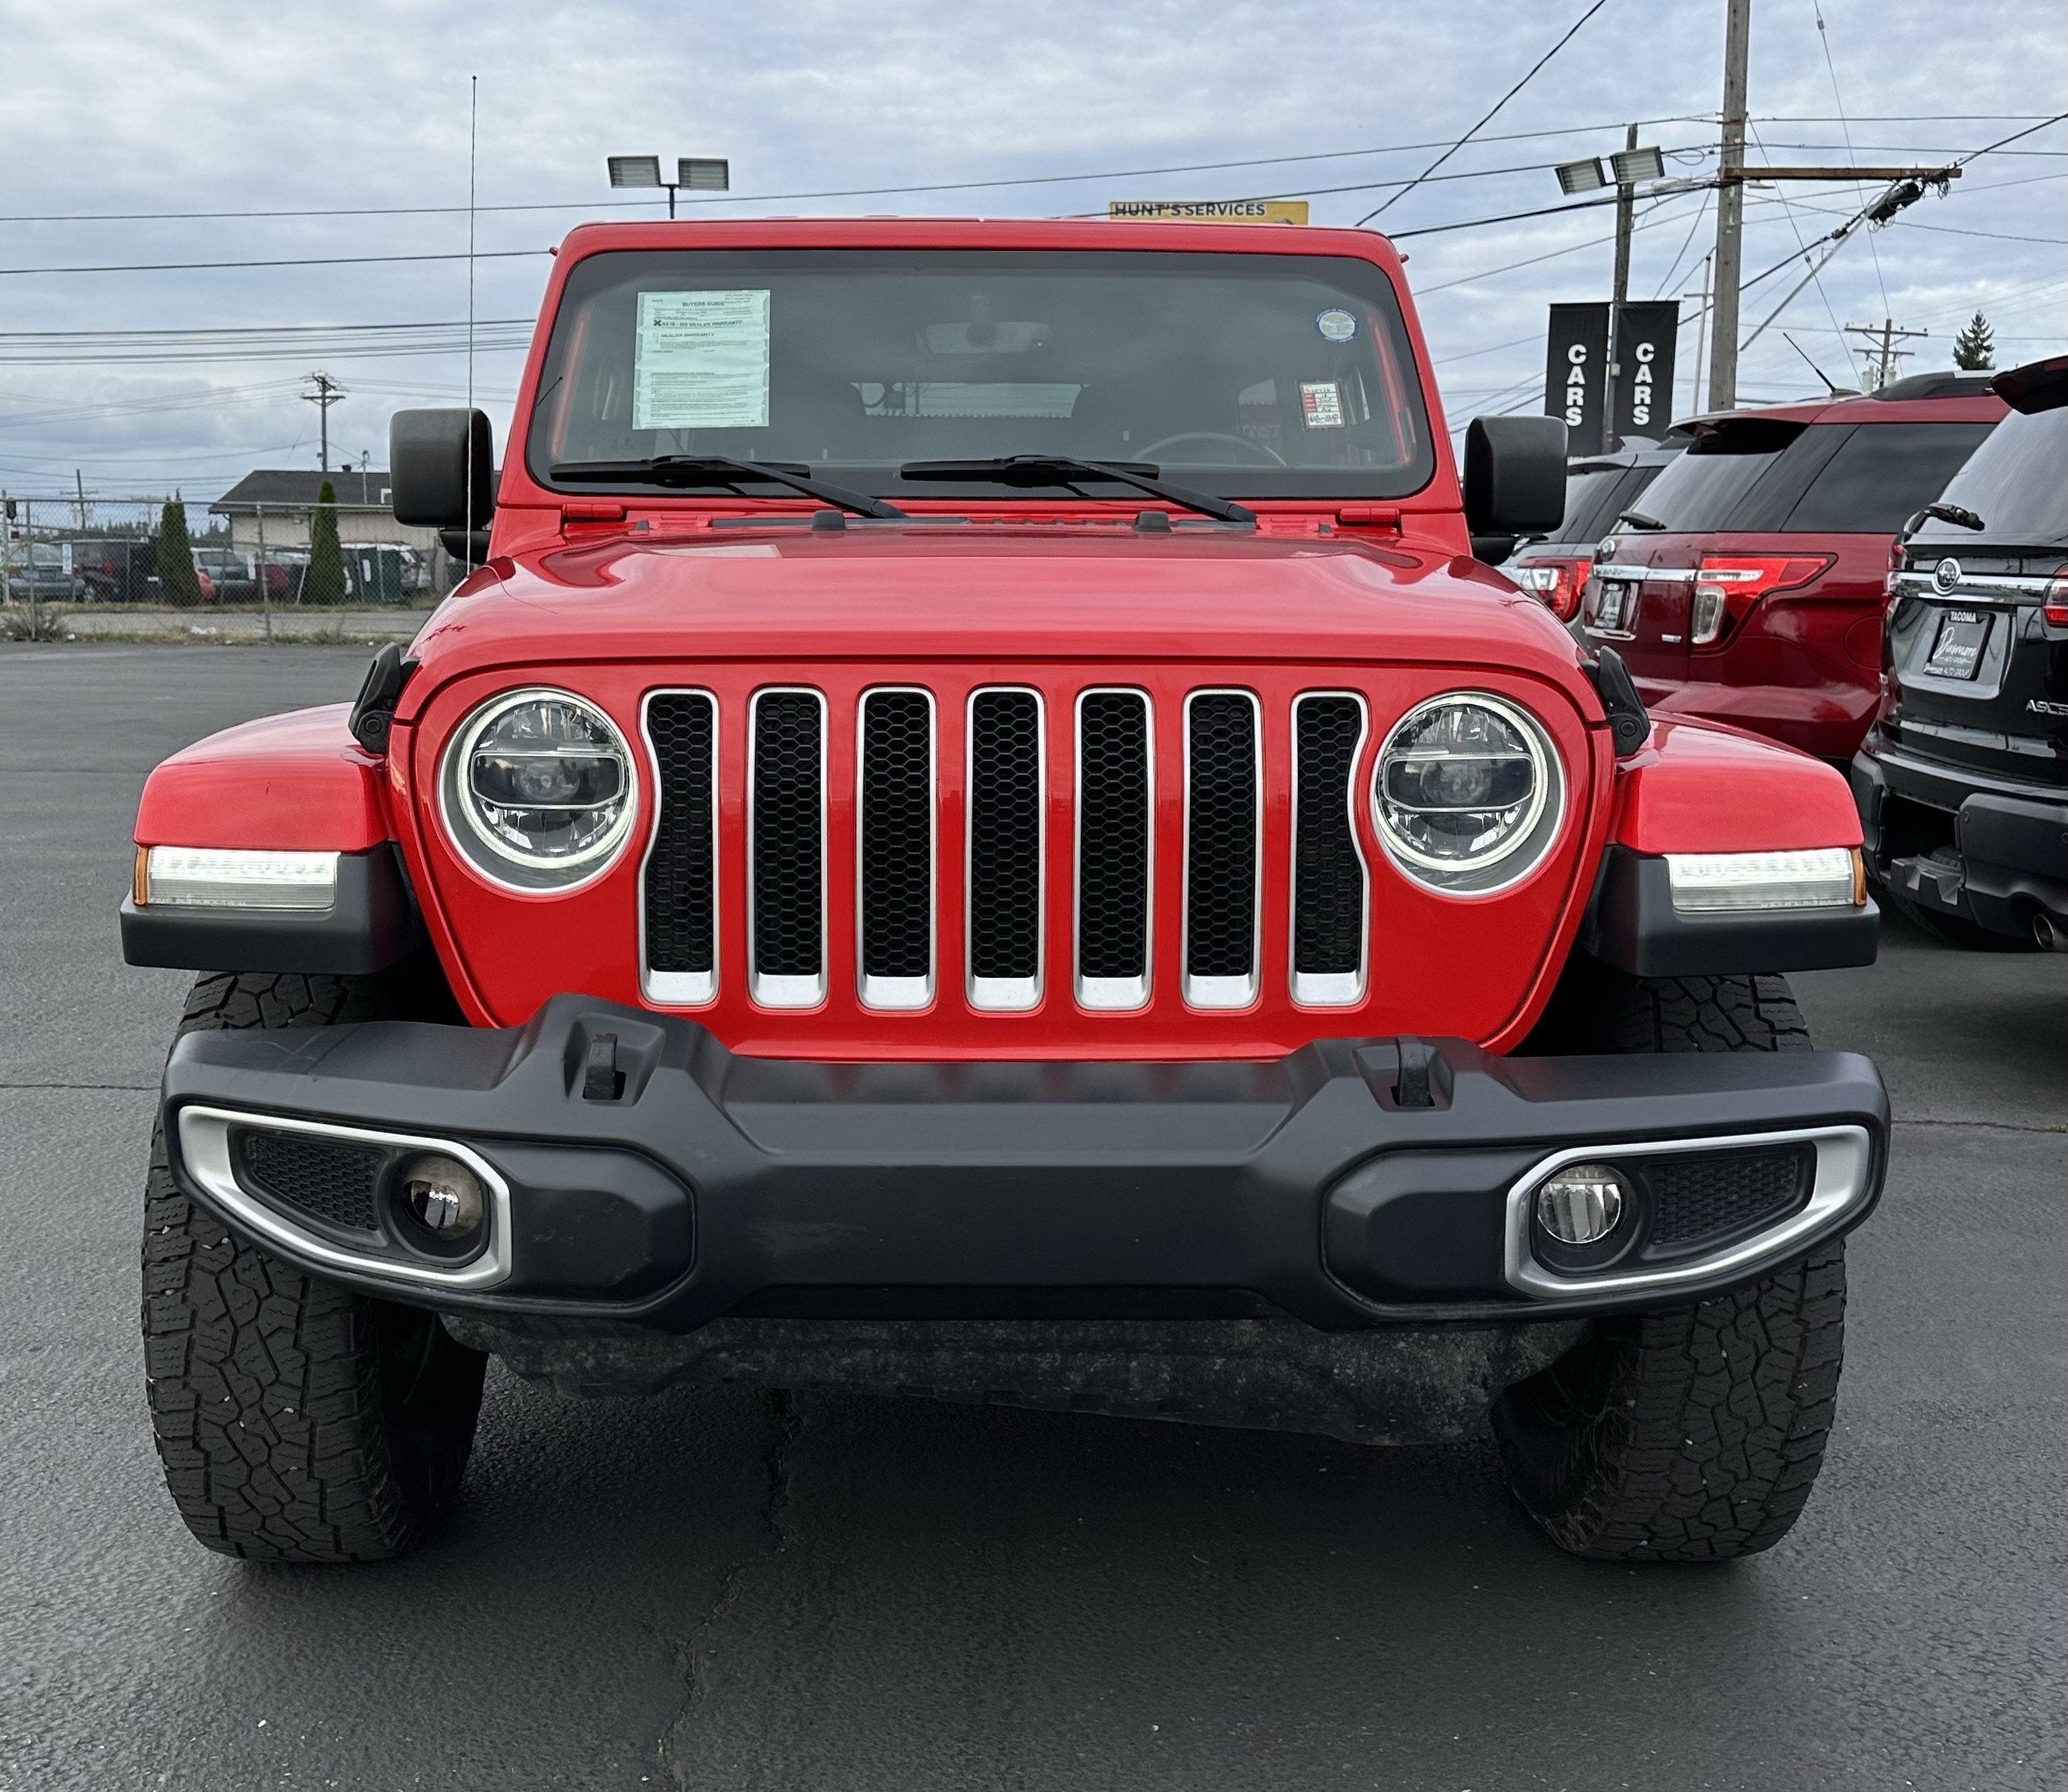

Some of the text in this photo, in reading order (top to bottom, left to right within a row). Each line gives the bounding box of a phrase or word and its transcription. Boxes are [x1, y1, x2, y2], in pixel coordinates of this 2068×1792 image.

[1115, 203, 1265, 216] HUNT'S SERVICES
[1565, 344, 1587, 427] CARS
[1633, 342, 1655, 425] CARS
[1951, 611, 1976, 623] TACOMA
